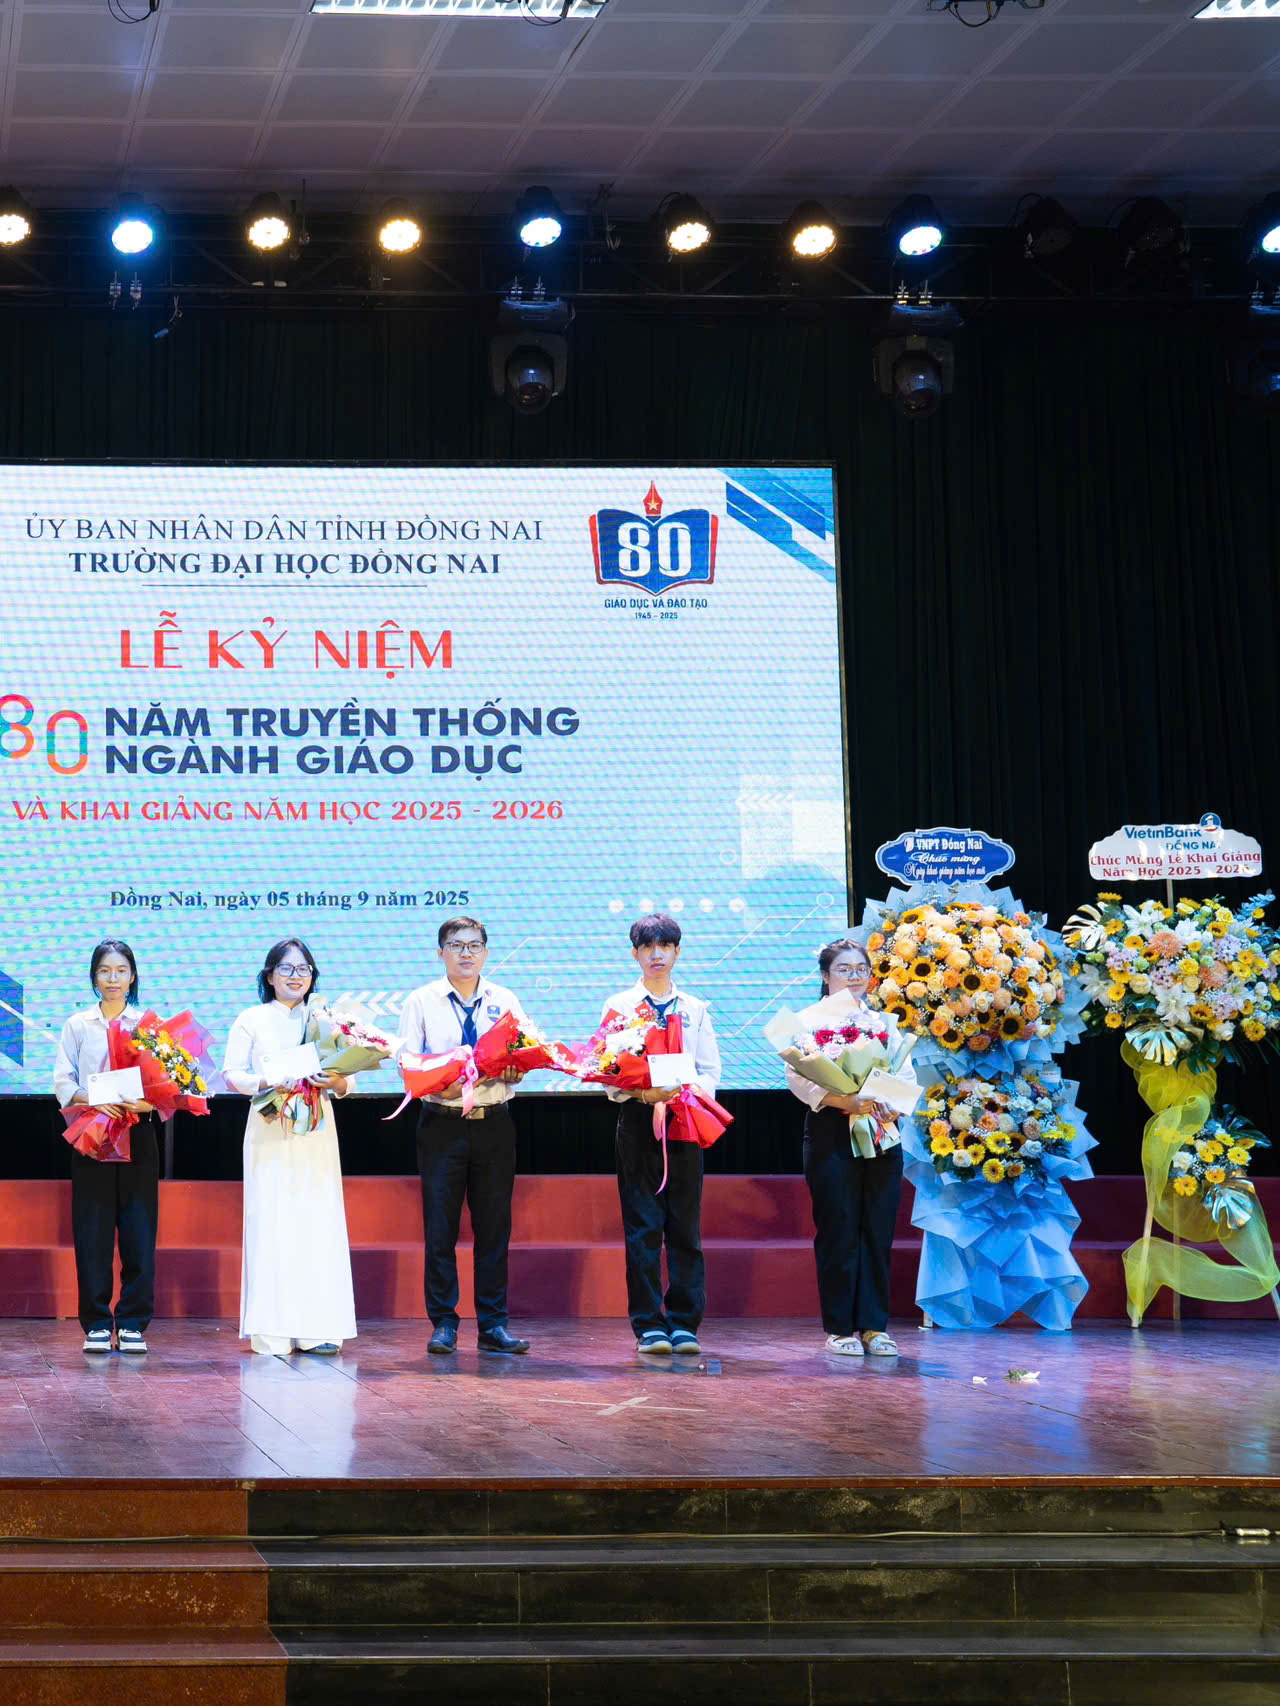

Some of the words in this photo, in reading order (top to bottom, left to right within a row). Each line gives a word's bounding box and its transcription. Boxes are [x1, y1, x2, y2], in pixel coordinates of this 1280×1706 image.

[26, 512, 67, 539] ỦY
[76, 519, 138, 540] BAN
[148, 513, 234, 541] NHÂN
[244, 514, 306, 541] DÂN
[316, 514, 386, 541] TỈNH
[396, 514, 481, 541] ĐỒNG
[489, 520, 543, 541] NAI
[69, 547, 201, 574] TRƯỜNG
[211, 553, 264, 579] ĐẠI
[274, 553, 340, 579] HỌC
[349, 548, 437, 575] ĐỒNG
[447, 553, 501, 574] NAI
[618, 521, 692, 578] 80
[604, 597, 627, 608] GIÁO
[630, 598, 649, 610] DỤC
[652, 597, 665, 608] VÀ
[690, 598, 708, 610] TẠO
[121, 610, 183, 669] LỄ
[208, 616, 288, 669] KỶ
[315, 619, 452, 680] NIỆM
[105, 701, 211, 737] NĂM
[226, 697, 396, 737] TRUYỀN
[413, 697, 580, 737] THỐNG
[105, 738, 279, 774] NGÀNH
[296, 738, 414, 774] GIÁO
[431, 744, 523, 781] DỤC
[12, 795, 49, 821] VÀ
[60, 800, 130, 821] KHAI
[141, 795, 233, 821] GIẢNG
[244, 796, 308, 821] NĂM
[320, 801, 381, 826] HỌC
[391, 800, 462, 821] 2025
[492, 800, 563, 820] 2026
[916, 839, 940, 850] VNPT
[967, 838, 983, 850] Nai
[1124, 826, 1202, 839] VietinBank
[1090, 853, 1121, 866] Chúc
[1187, 852, 1217, 863] Khai
[1138, 867, 1163, 879] Học
[1168, 866, 1201, 876] 2025
[110, 887, 162, 911] Đồng
[168, 891, 208, 909] Nai,
[215, 892, 261, 911] ngày
[267, 891, 290, 907] 05
[296, 891, 352, 911] tháng
[357, 890, 369, 906] 9
[375, 892, 417, 906] năm
[424, 890, 469, 906] 2025
